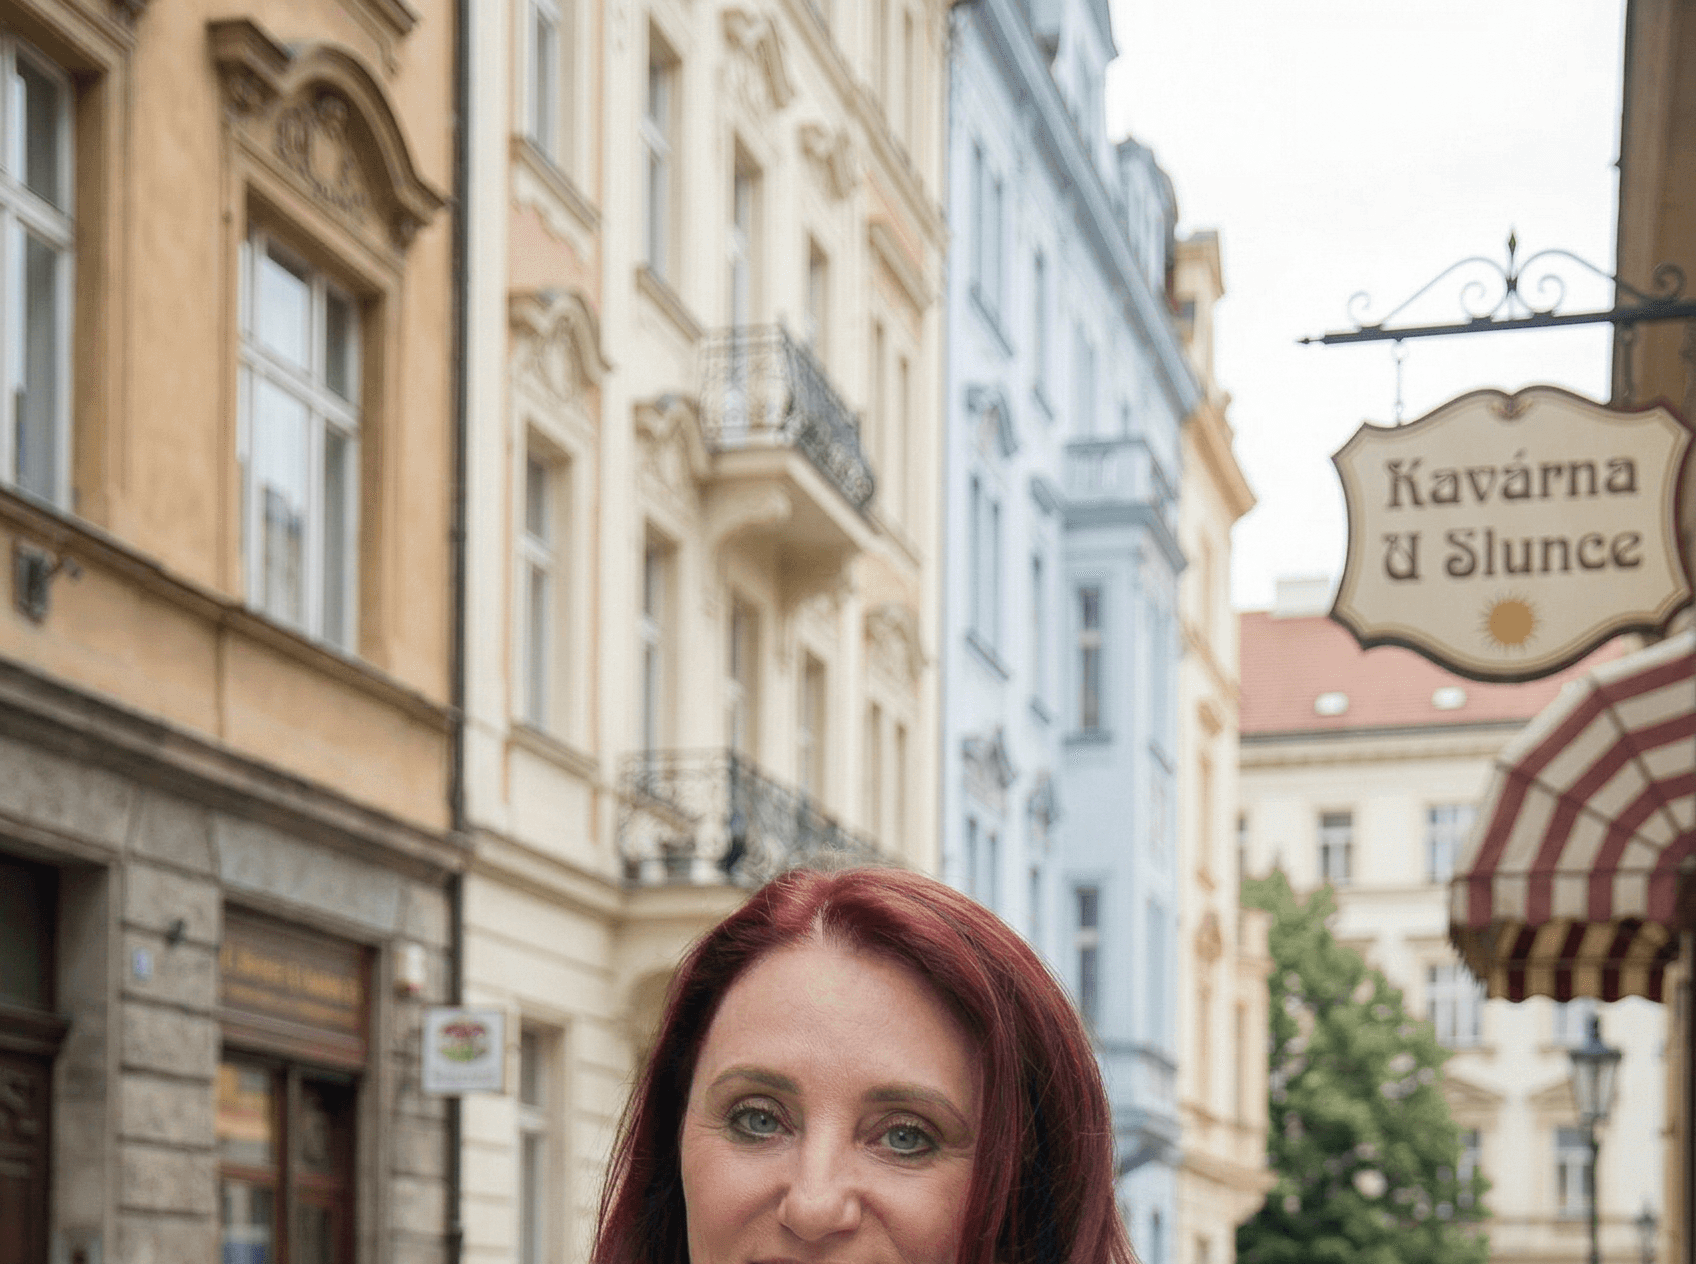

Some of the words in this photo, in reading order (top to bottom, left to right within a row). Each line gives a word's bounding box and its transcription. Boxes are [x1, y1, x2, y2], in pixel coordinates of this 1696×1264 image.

[1386, 449, 1638, 508] Kavárna
[1383, 531, 1421, 581] U
[1444, 526, 1643, 578] Slunce
